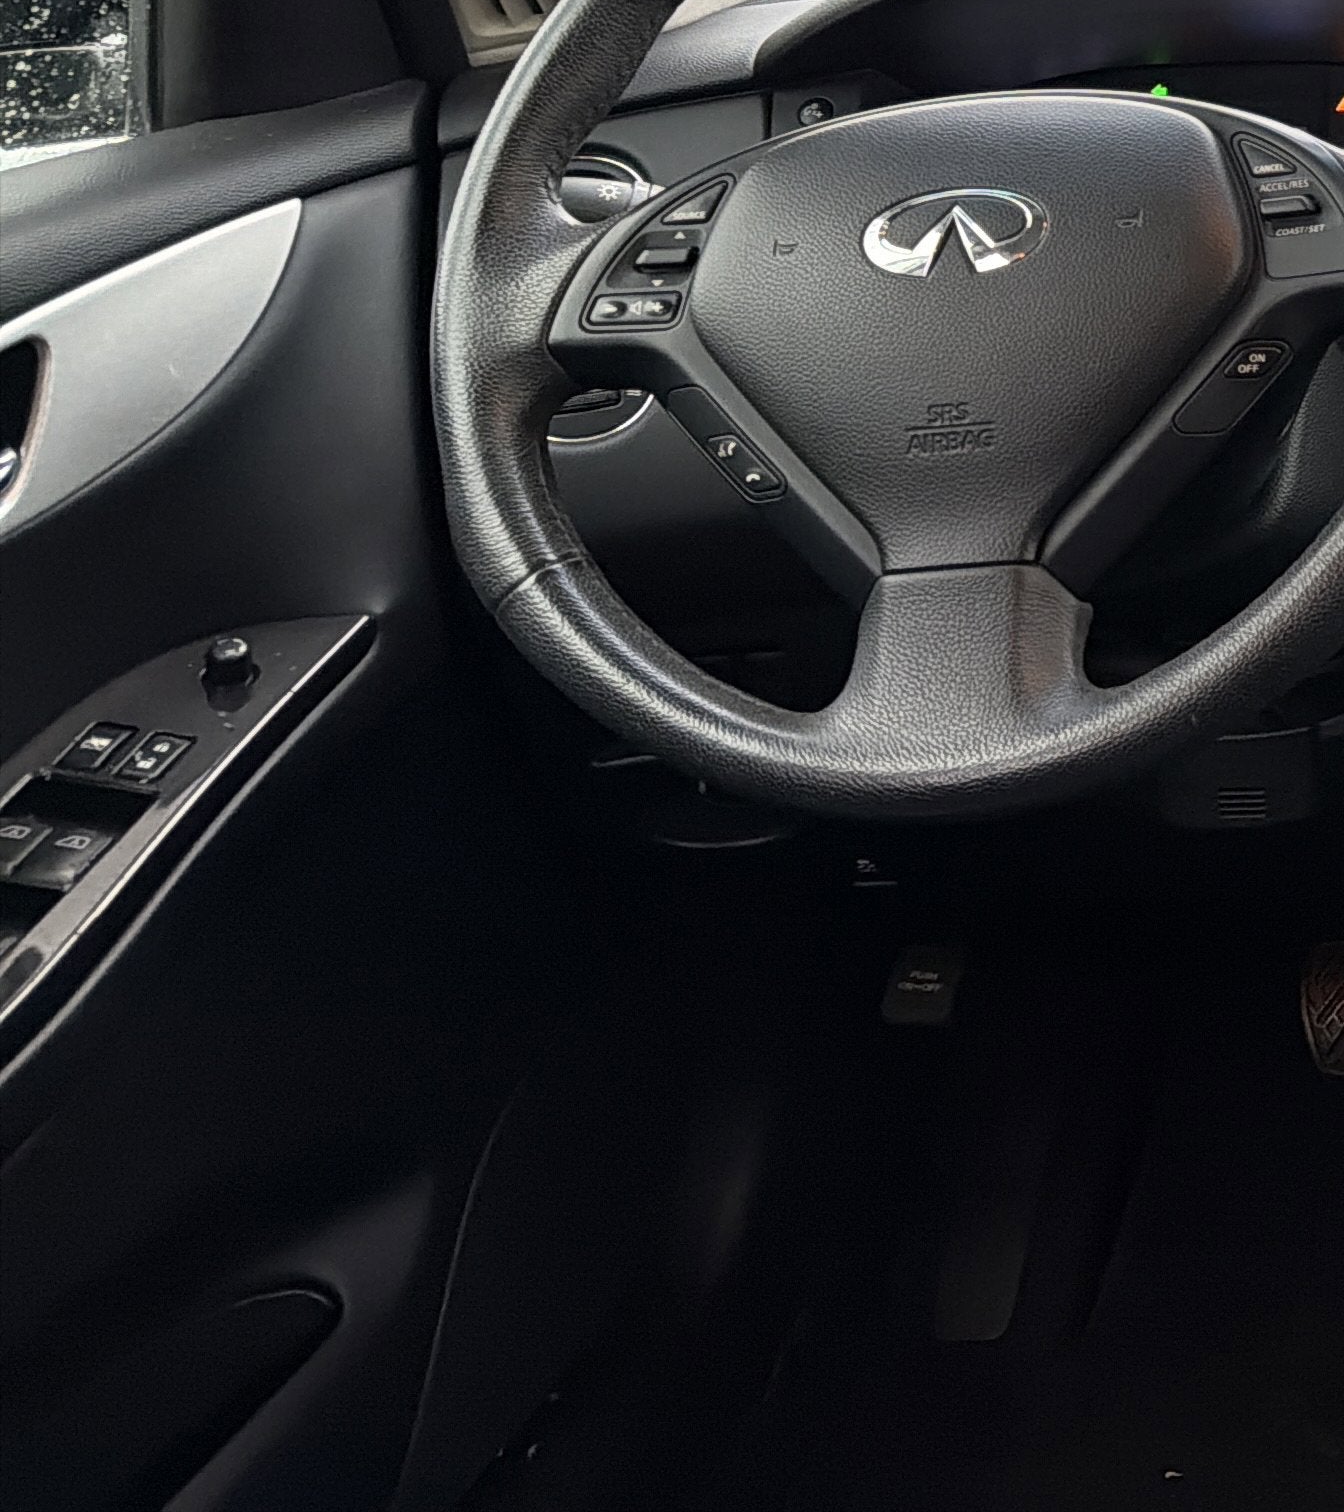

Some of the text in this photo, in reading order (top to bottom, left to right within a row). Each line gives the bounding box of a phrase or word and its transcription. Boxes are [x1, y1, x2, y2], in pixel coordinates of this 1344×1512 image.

[1252, 163, 1285, 175] CANCEL
[1258, 179, 1310, 193] ACCEL/RES
[1275, 223, 1326, 237] COAST/SET
[1248, 353, 1266, 363] ON
[1237, 364, 1260, 374] OFF
[927, 401, 969, 424] SRS
[905, 428, 996, 455] AIRBAG
